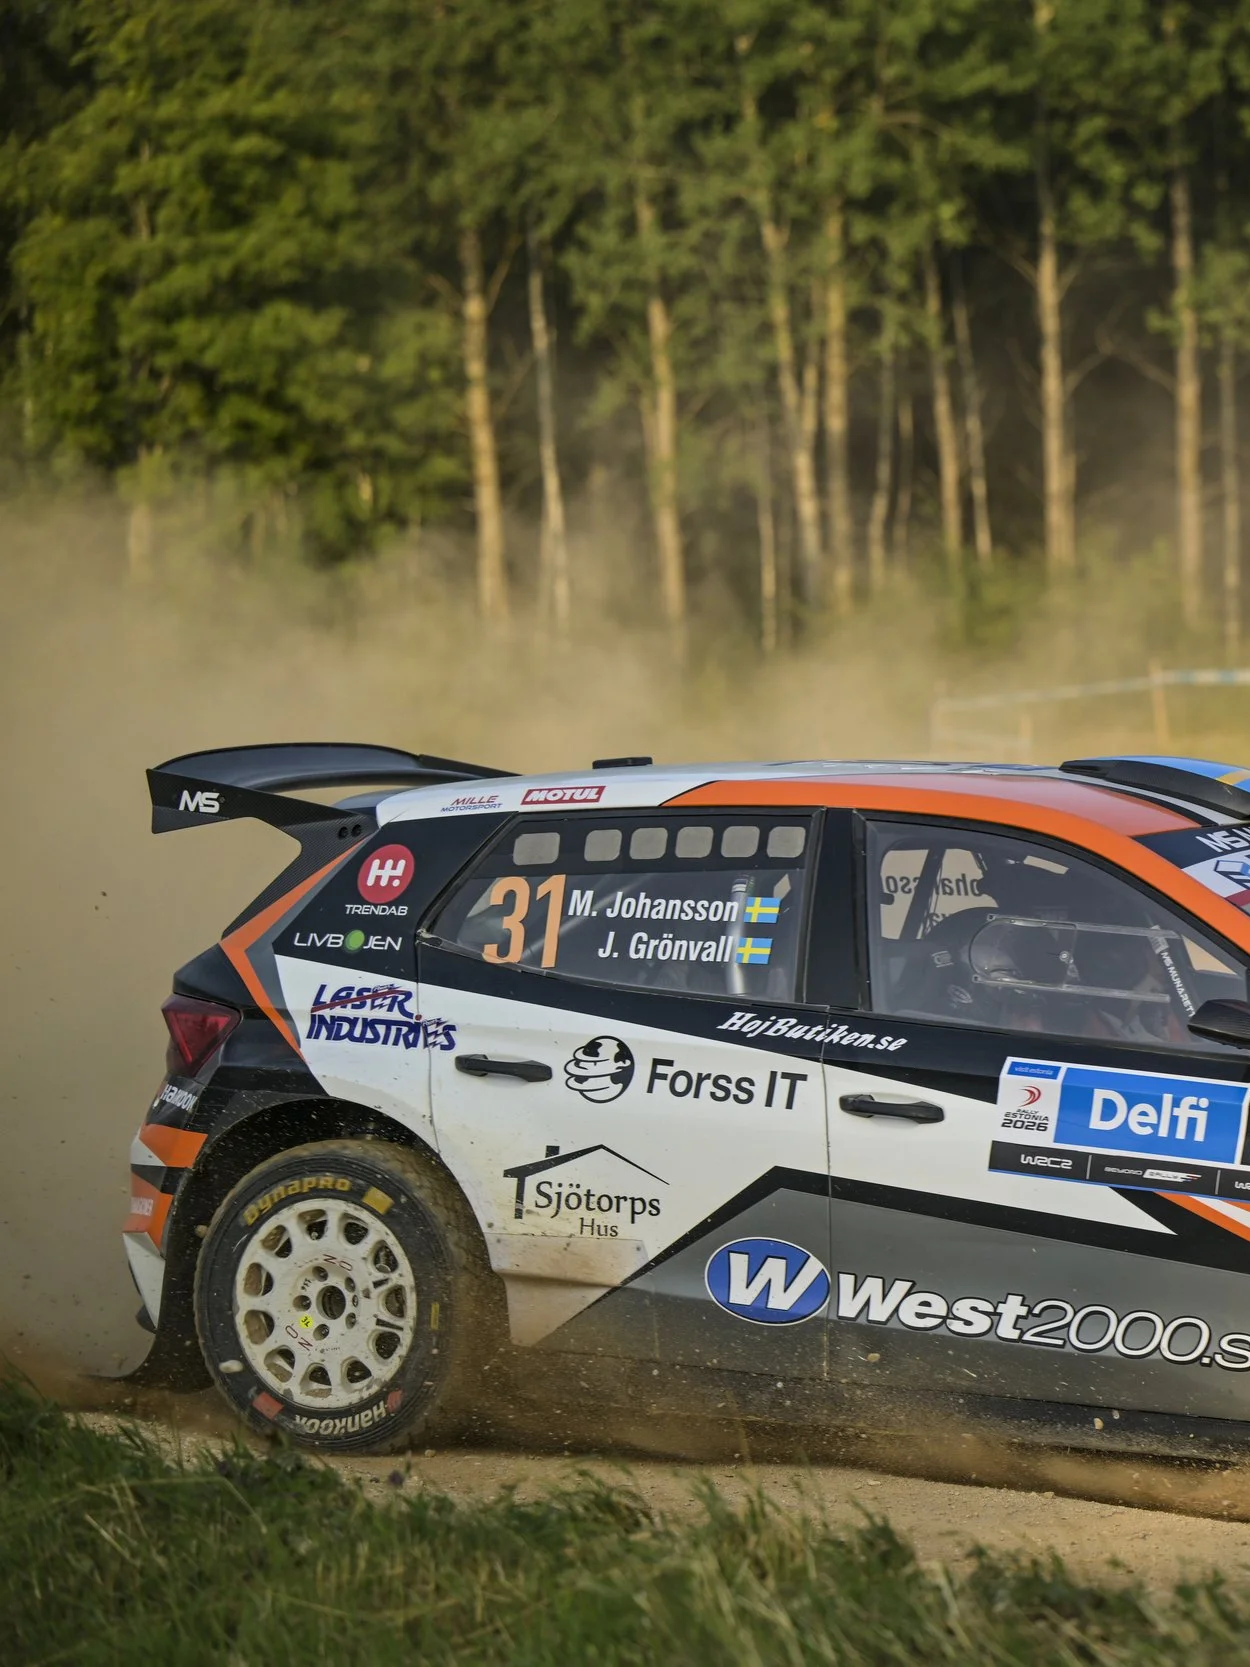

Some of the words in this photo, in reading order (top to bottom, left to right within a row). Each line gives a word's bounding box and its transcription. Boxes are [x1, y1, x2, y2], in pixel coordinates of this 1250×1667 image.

[178, 790, 221, 814] MS
[440, 803, 502, 812] MOTORSPORT
[451, 795, 499, 806] MILLE
[526, 787, 600, 802] MOTUL
[1195, 830, 1250, 852] MS
[345, 904, 408, 916] TRENDAB
[568, 889, 597, 917] M.
[606, 891, 740, 922] Johansson
[481, 873, 567, 968] 31
[598, 931, 618, 958] J.
[629, 931, 735, 962] Grönvall
[311, 984, 414, 1020] LASER
[306, 1013, 457, 1051] INDUSTRIES
[716, 1011, 908, 1051] HojButiken.se
[646, 1057, 756, 1104] Forss
[765, 1070, 808, 1110] IT
[1001, 1118, 1049, 1132] 2026
[1004, 1111, 1049, 1122] ESTONIA
[1089, 1088, 1209, 1142] Delfi
[1020, 1153, 1073, 1170] WRC2
[535, 1180, 661, 1224] Sjötorps
[579, 1217, 618, 1237] Hus
[727, 1250, 827, 1311] W
